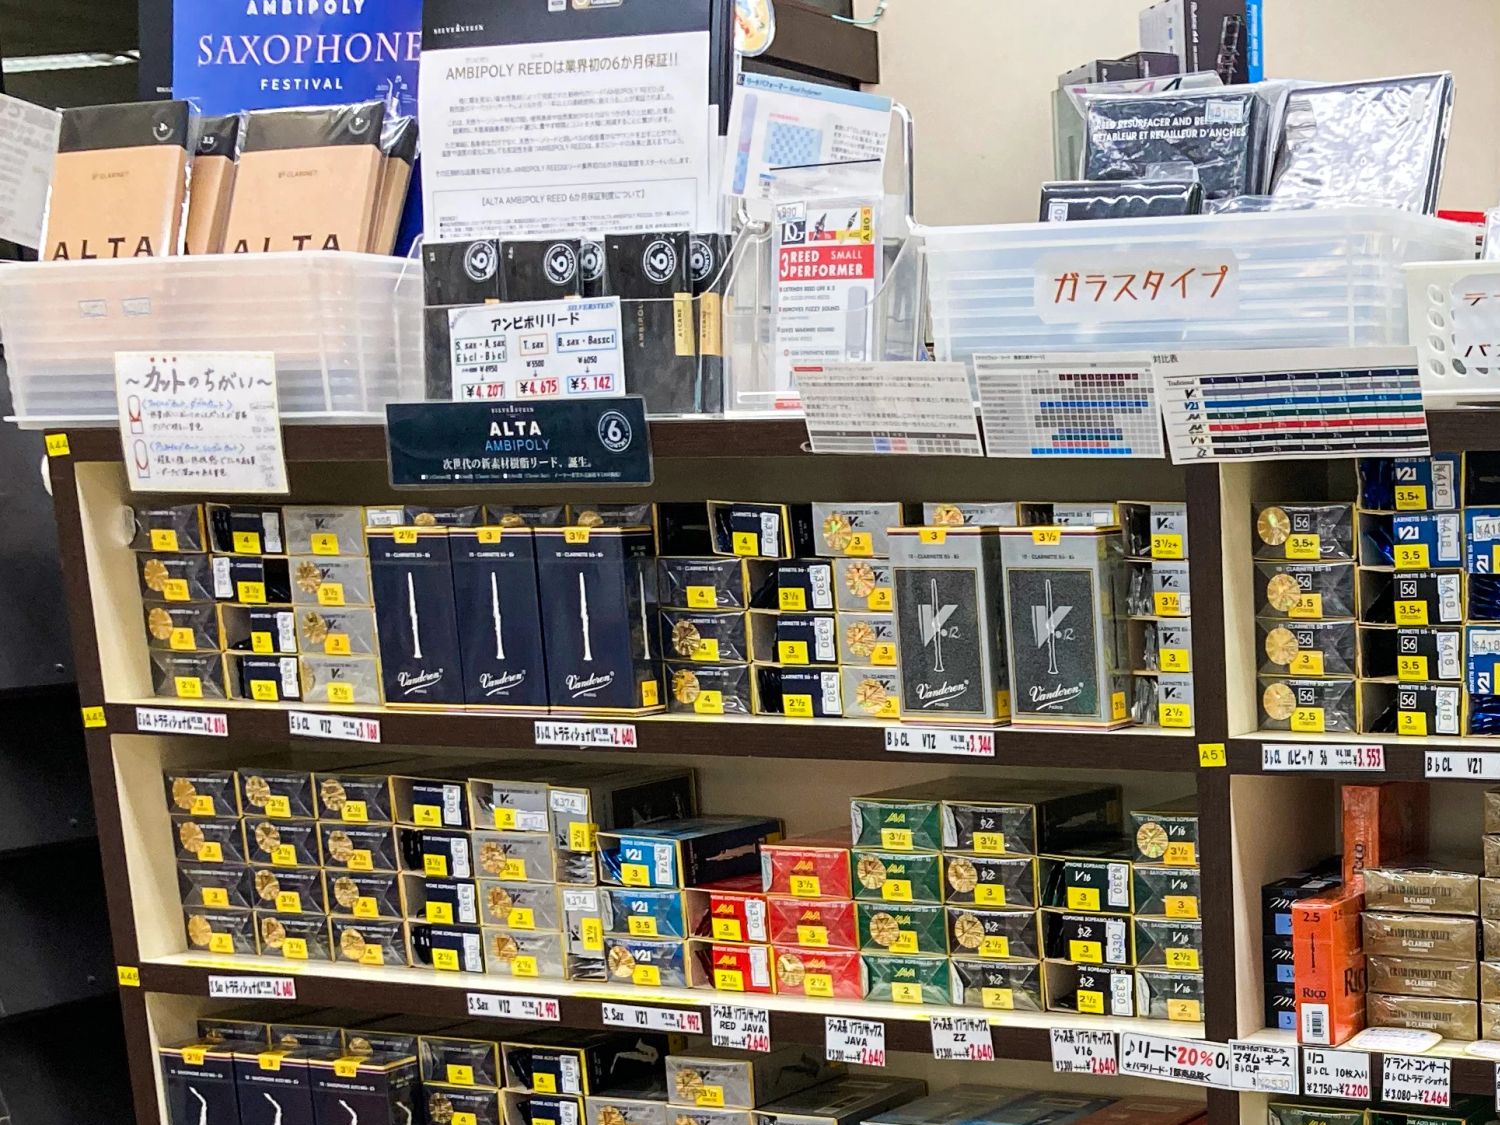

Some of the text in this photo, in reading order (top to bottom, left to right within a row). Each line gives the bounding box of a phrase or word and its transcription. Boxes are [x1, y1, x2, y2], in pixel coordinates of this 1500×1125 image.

[247, 0, 364, 15] AMBIPOLY
[198, 31, 422, 66] SAXOPHONE
[446, 64, 514, 80] AMBIPOLY
[261, 78, 343, 90] FESTIVAL
[1172, 117, 1191, 126] AND
[1139, 131, 1148, 140] ET
[54, 236, 154, 261] ALTA
[791, 251, 862, 262] REED SMALL
[790, 264, 863, 277] PERFORMER
[1054, 264, 1229, 304] ガラスタイプ
[490, 421, 541, 436] ALTA
[485, 439, 550, 451] AMBIPOLY
[1397, 467, 1416, 480] V21
[1296, 516, 1308, 529] 56
[1399, 526, 1418, 540] V21
[916, 682, 968, 700] Vandoren
[1029, 684, 1084, 703] Vandoren
[1202, 748, 1225, 762] A51
[1467, 757, 1482, 774] V21
[1304, 912, 1320, 922] 2.5
[719, 1021, 765, 1034] RED JAVA
[844, 1036, 869, 1048] JAVA
[953, 1032, 966, 1042] ZZ
[1074, 1045, 1093, 1056] V16
[1308, 1053, 1324, 1064] リコ
